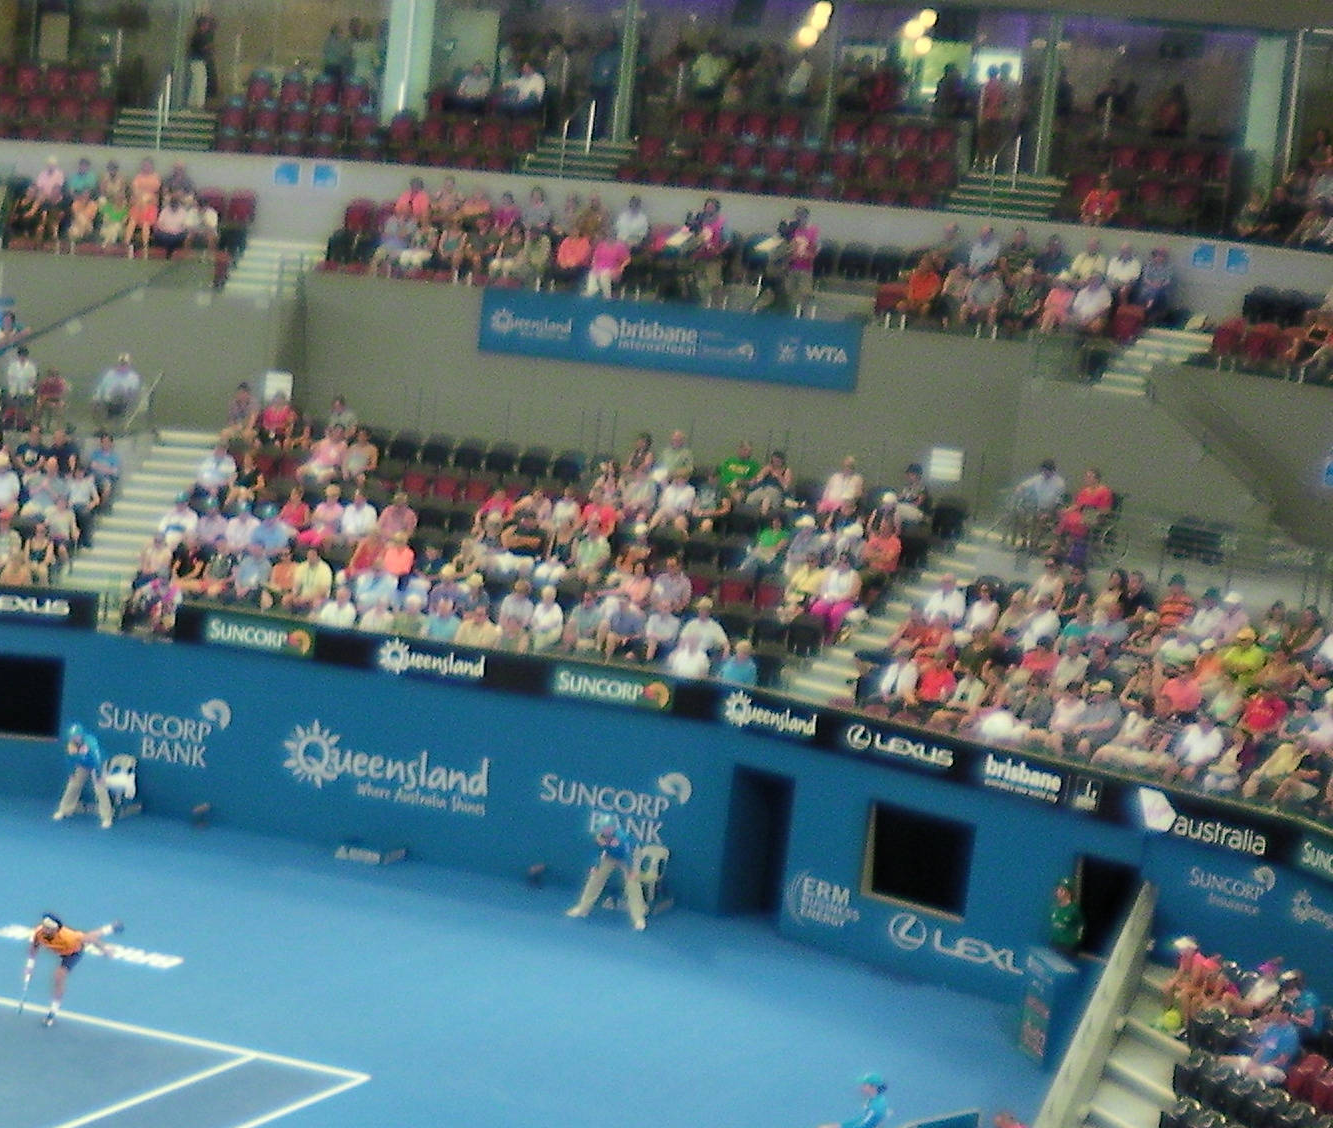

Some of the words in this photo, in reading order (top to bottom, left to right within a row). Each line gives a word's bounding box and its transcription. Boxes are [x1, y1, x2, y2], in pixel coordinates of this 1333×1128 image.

[619, 317, 699, 343] brisbane
[805, 343, 848, 364] WTA
[207, 618, 288, 651] SUNCORP
[379, 636, 485, 680] Queensland
[556, 669, 644, 702] SUNCORP
[98, 701, 213, 744] SUNCORP
[724, 690, 817, 738] Queensland
[141, 736, 206, 769] BANK
[282, 719, 490, 798] Queensland
[874, 735, 954, 769] LEXUS
[984, 752, 1063, 793] brisbane
[540, 773, 670, 819] SUNCORP
[1173, 814, 1268, 857] australia
[803, 876, 851, 907] ERM
[1189, 865, 1264, 901] SUNCORP
